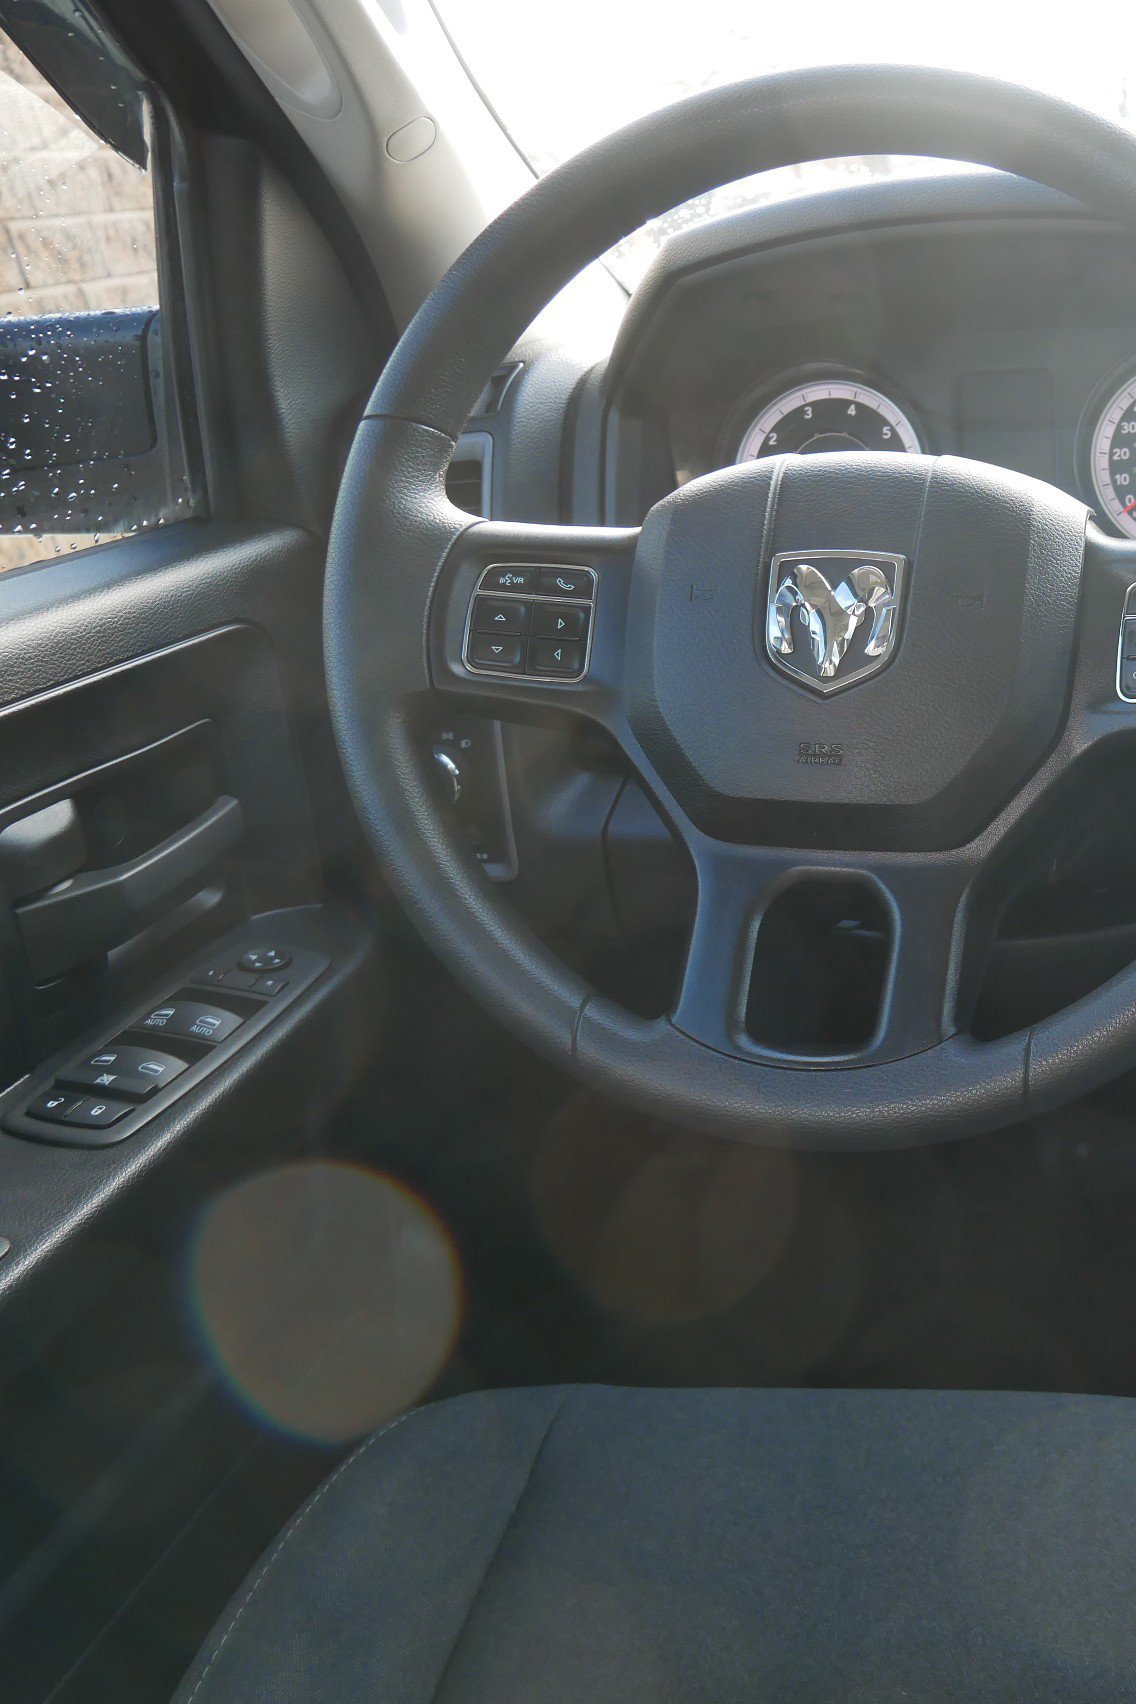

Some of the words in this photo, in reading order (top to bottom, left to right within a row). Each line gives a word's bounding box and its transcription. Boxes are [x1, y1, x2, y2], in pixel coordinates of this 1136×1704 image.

[803, 406, 813, 419] 3
[846, 404, 857, 416] 4
[768, 432, 778, 445] 2
[882, 426, 892, 439] 5
[1112, 447, 1130, 460] 20
[1114, 473, 1130, 485] 10
[1125, 494, 1135, 506] 0
[799, 742, 844, 755] SRS
[189, 1024, 213, 1036] AUTO
